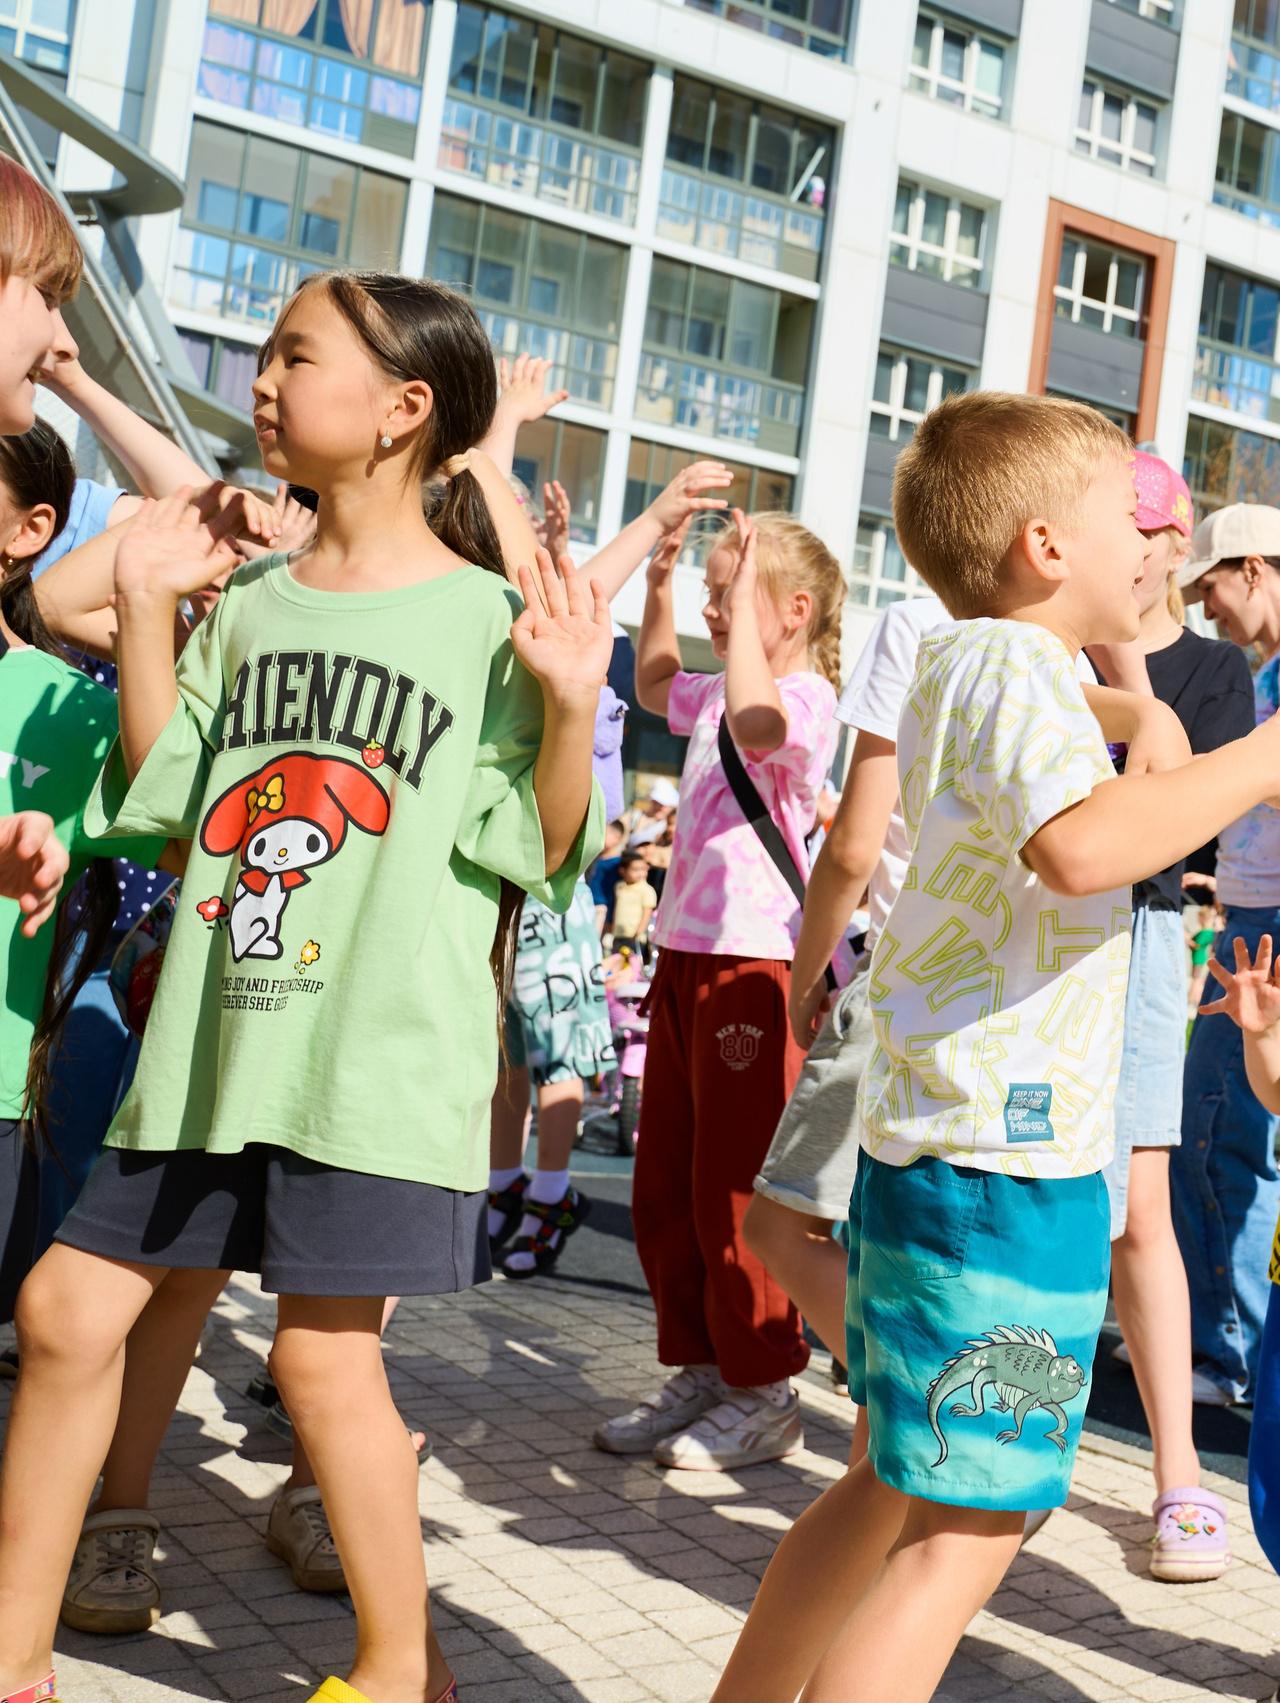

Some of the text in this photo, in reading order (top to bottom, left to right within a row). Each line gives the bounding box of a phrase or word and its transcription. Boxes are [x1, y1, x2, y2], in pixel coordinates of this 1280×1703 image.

[216, 650, 456, 795] RIENDLY
[232, 976, 246, 991] JOY
[245, 977, 269, 993] AND
[270, 978, 324, 994] FRIENDSHIP
[248, 996, 273, 1012] SHE
[715, 1023, 764, 1040] NEW YORK
[720, 1032, 759, 1062] 80
[1012, 1090, 1049, 1098] KEEP IT NOW
[1009, 1098, 1044, 1110] ONE
[1007, 1108, 1030, 1121] OF
